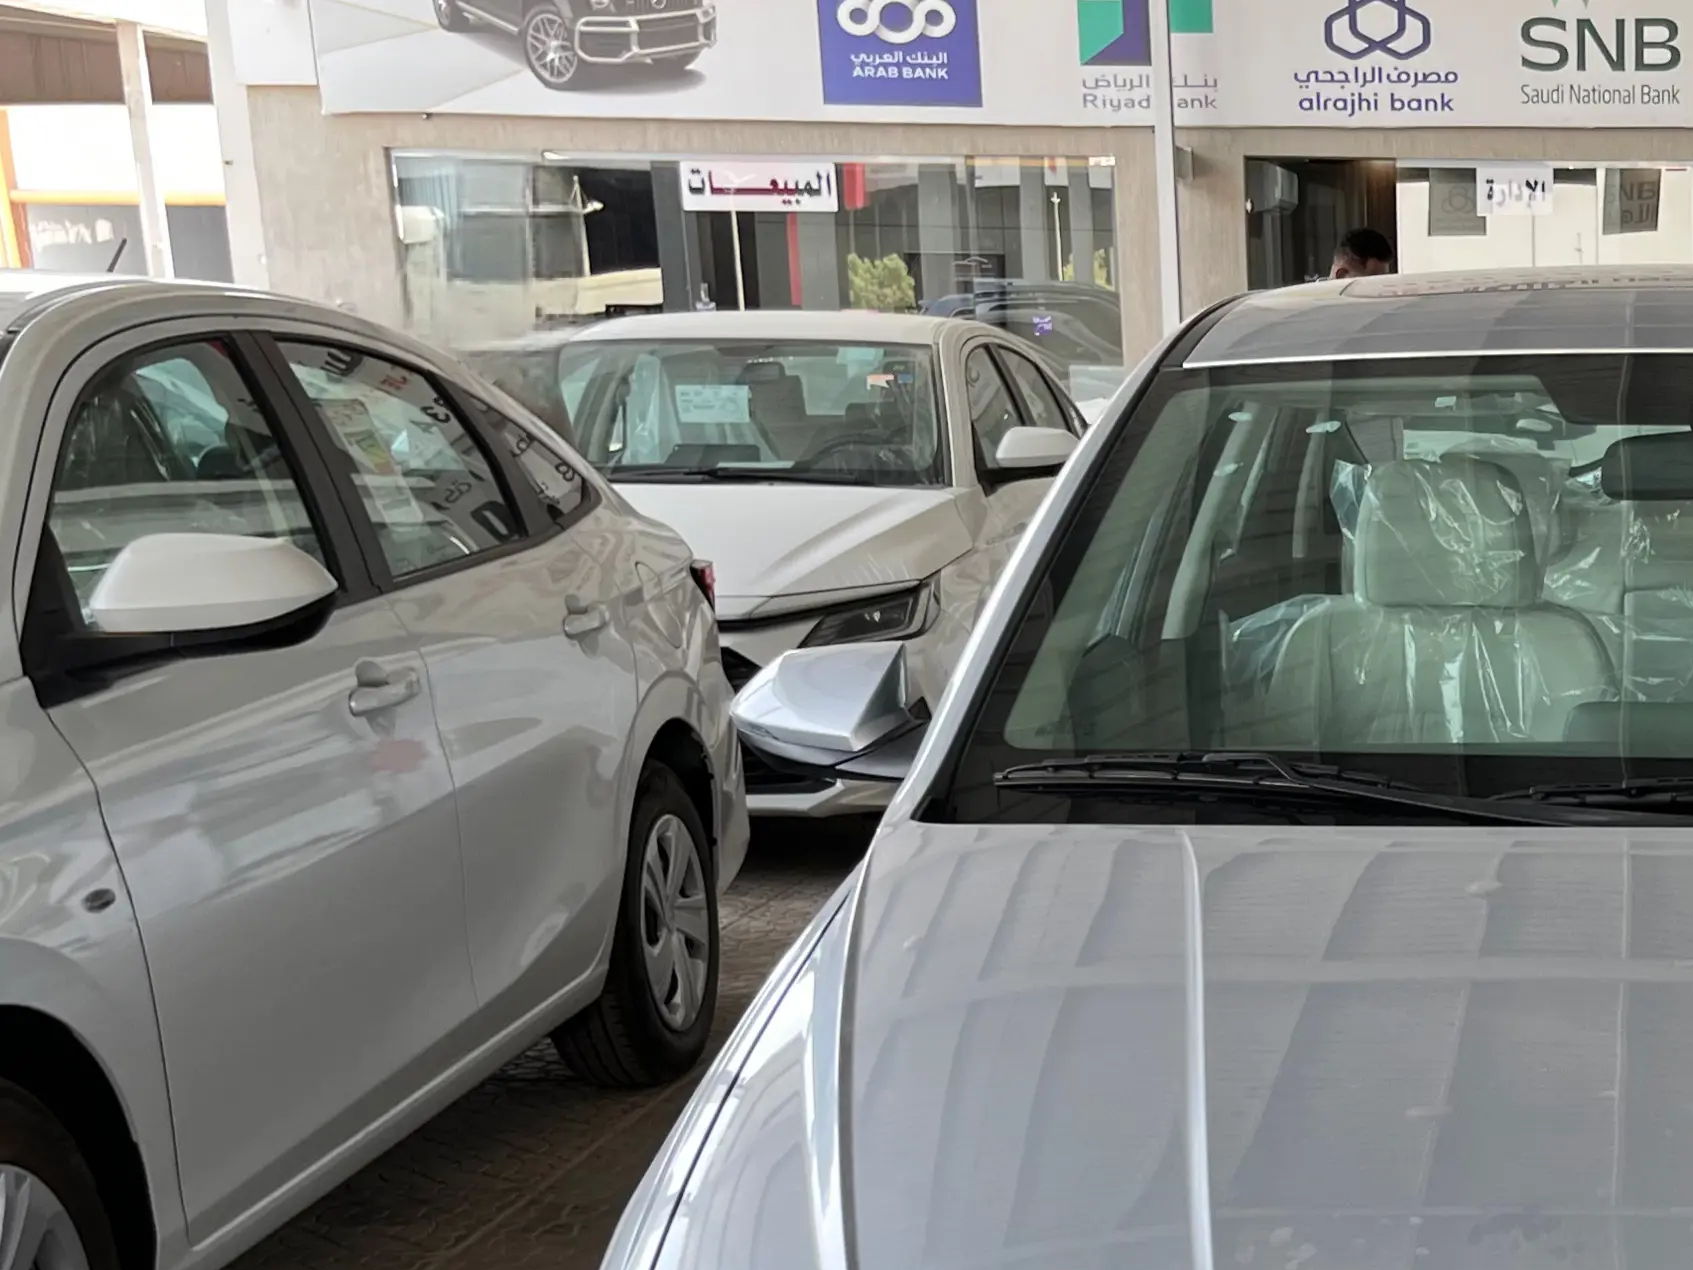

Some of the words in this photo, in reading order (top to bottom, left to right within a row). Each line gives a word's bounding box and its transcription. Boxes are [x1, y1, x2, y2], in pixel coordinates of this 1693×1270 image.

[1521, 17, 1681, 72] SNB
[850, 50, 903, 67] العربي
[906, 51, 948, 66] البنك
[852, 66, 899, 79] ARAB
[902, 66, 949, 80] BANK
[1082, 74, 1150, 92] الرياض
[1293, 66, 1383, 90] الراجحي
[1386, 66, 1459, 88] مصرف
[1082, 93, 1151, 112] Riyad
[1176, 94, 1218, 110] ank
[1298, 92, 1379, 117] alrajhi
[1390, 93, 1454, 112] bank
[1520, 84, 1565, 105] Saudi
[1569, 84, 1636, 105] National
[1641, 84, 1681, 105] Bank
[688, 167, 832, 205] المبيعات
